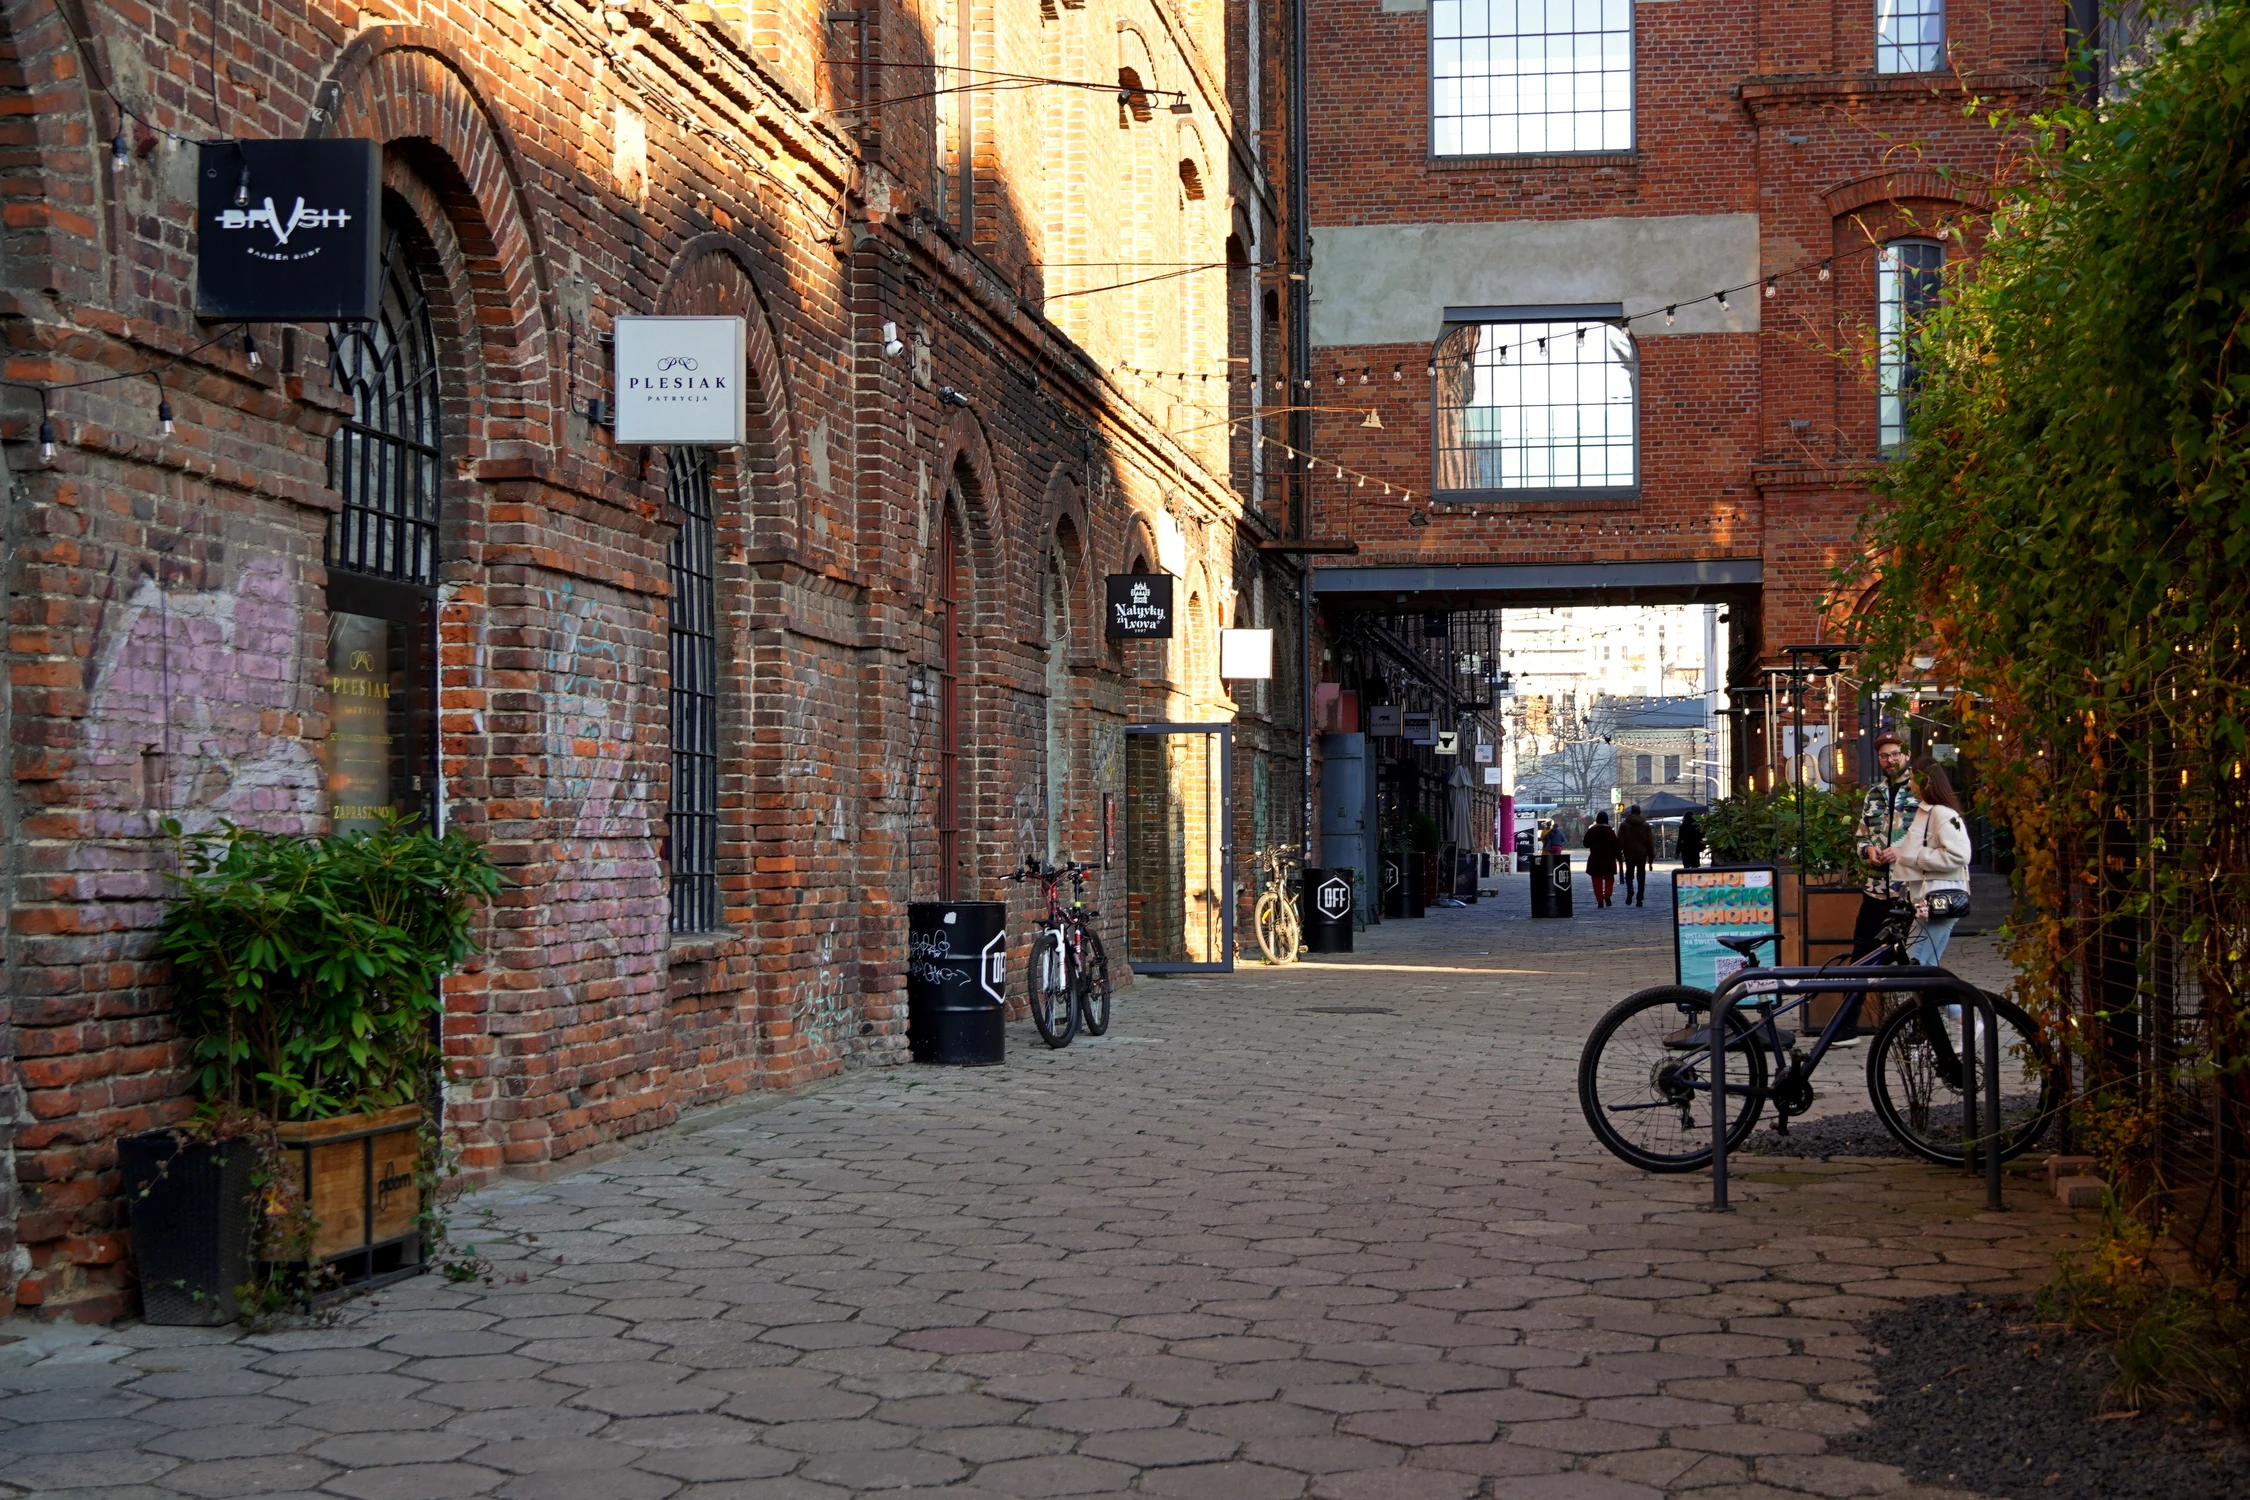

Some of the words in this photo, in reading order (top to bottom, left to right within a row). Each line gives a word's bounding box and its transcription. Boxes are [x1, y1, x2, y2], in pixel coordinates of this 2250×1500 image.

[629, 377, 726, 389] PLESIAK
[332, 677, 390, 699] PLESIAK
[333, 805, 390, 820] ZAPRASZAMY
[1558, 870, 1569, 883] OFF
[1324, 887, 1346, 908] OFF
[1678, 908, 1774, 926] HOHOHO
[1694, 938, 1720, 946] ŚWIĄTE
